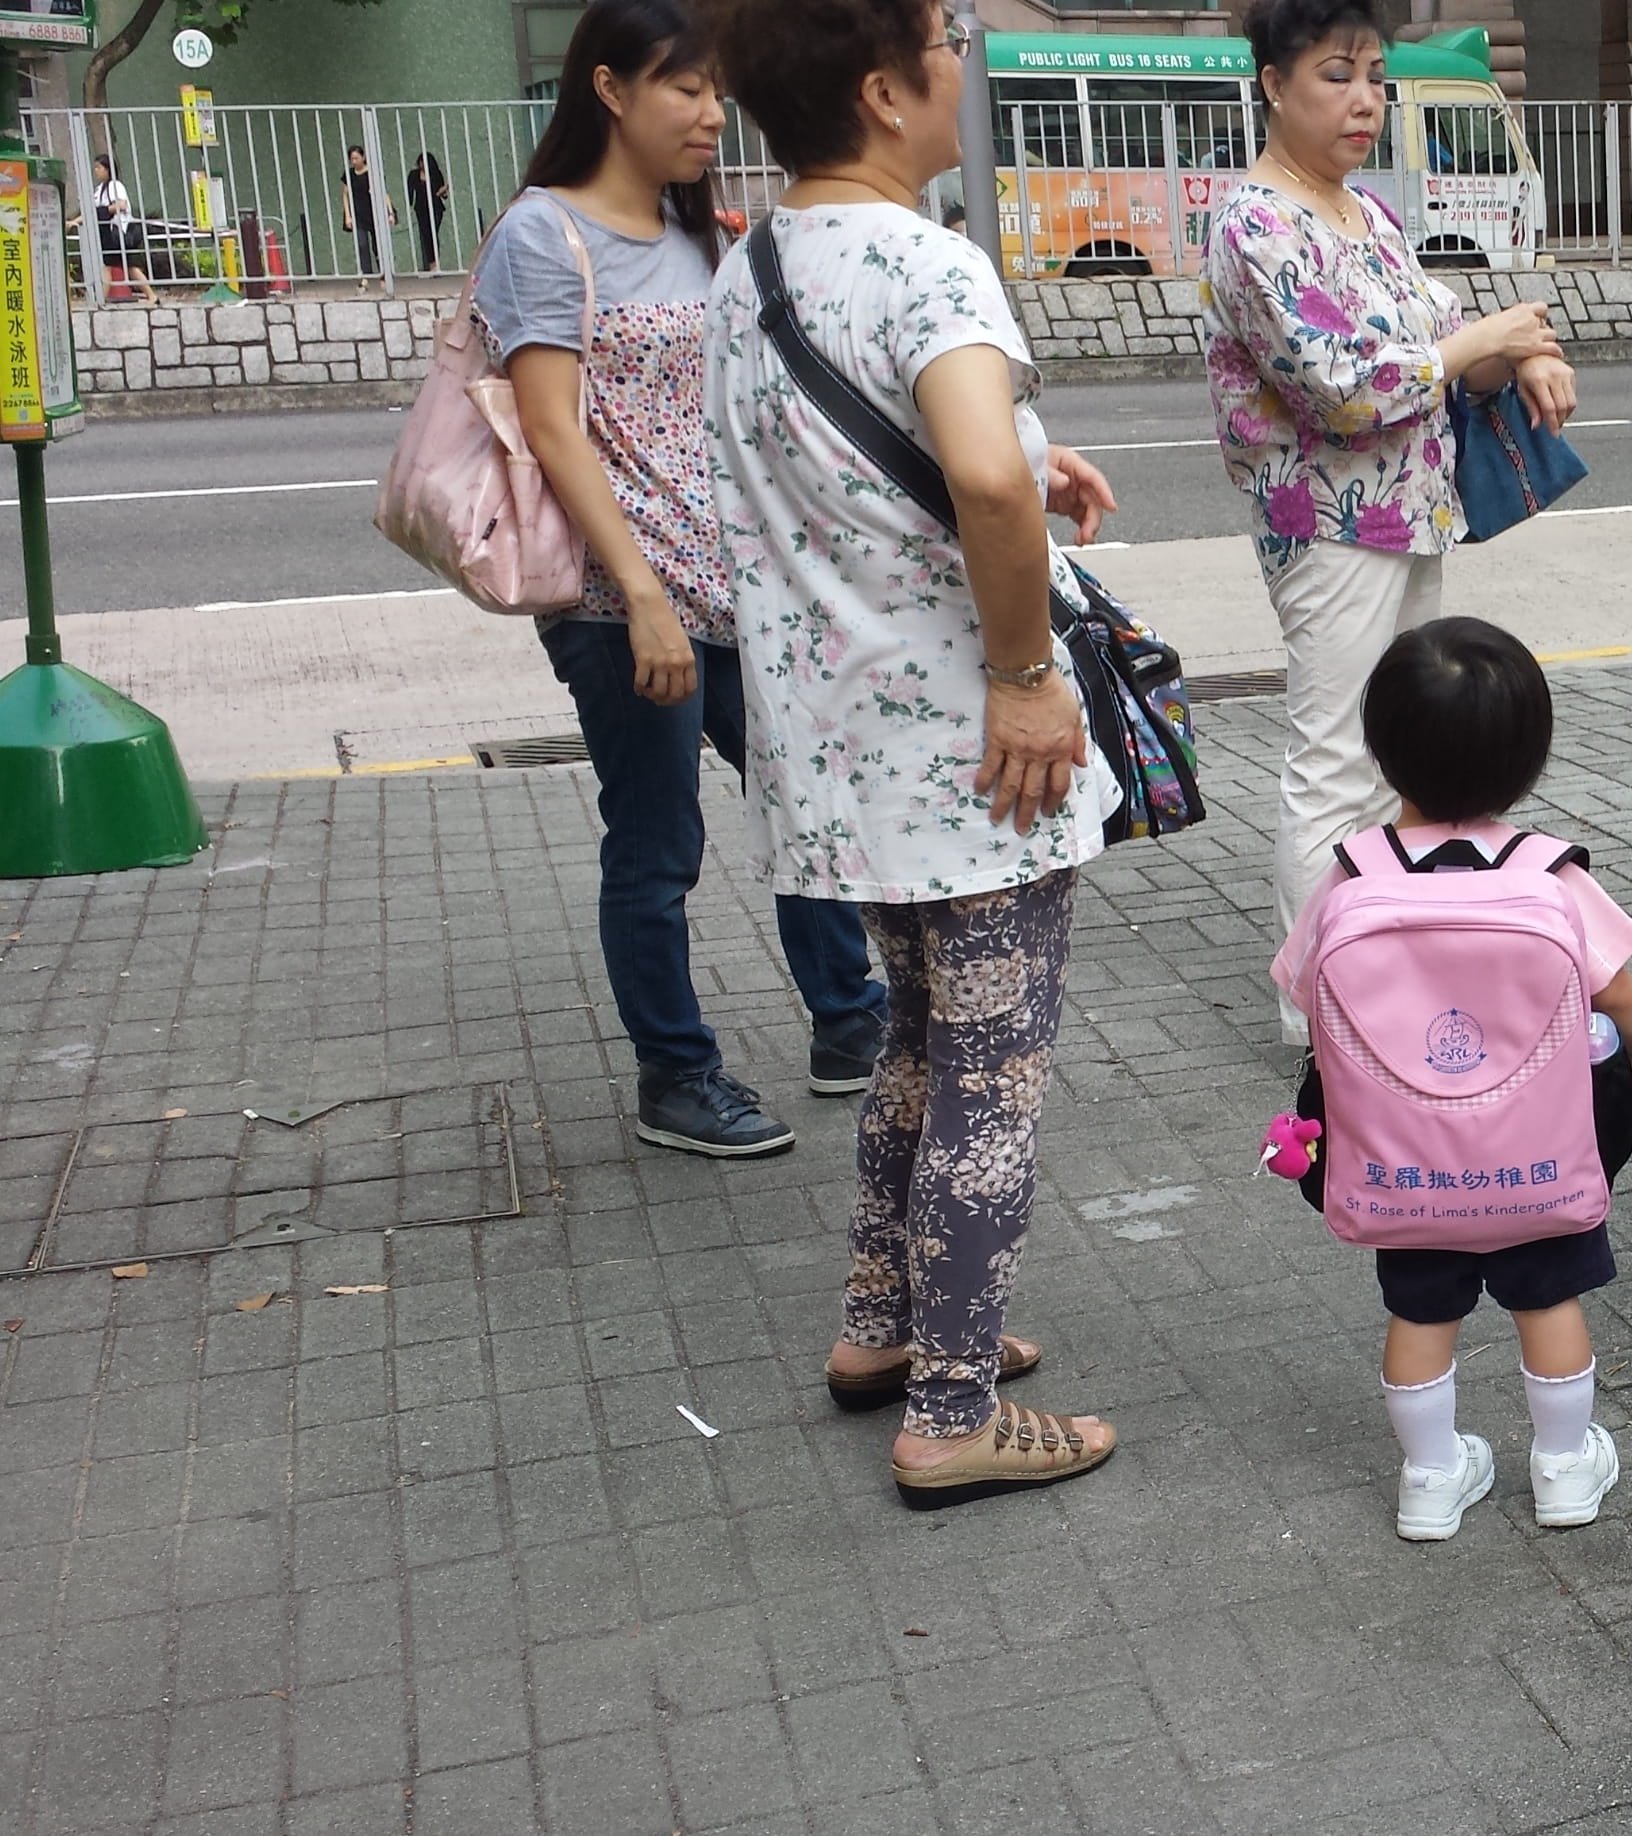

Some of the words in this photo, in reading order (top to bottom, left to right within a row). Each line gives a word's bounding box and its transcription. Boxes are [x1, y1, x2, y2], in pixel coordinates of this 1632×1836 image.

[176, 39, 209, 59] 15A
[1018, 52, 1063, 67] PUBLIC
[1067, 52, 1101, 67] LIGHT
[1109, 53, 1133, 68] BUS
[1137, 54, 1151, 68] 16
[1155, 55, 1192, 69] SEATS
[1364, 1159, 1558, 1190] 聖羅撒幼稚園
[1370, 1201, 1405, 1216] Rose
[1410, 1205, 1426, 1217] of
[1432, 1205, 1479, 1218] Lima's
[1484, 1189, 1585, 1217] Kindergarten
